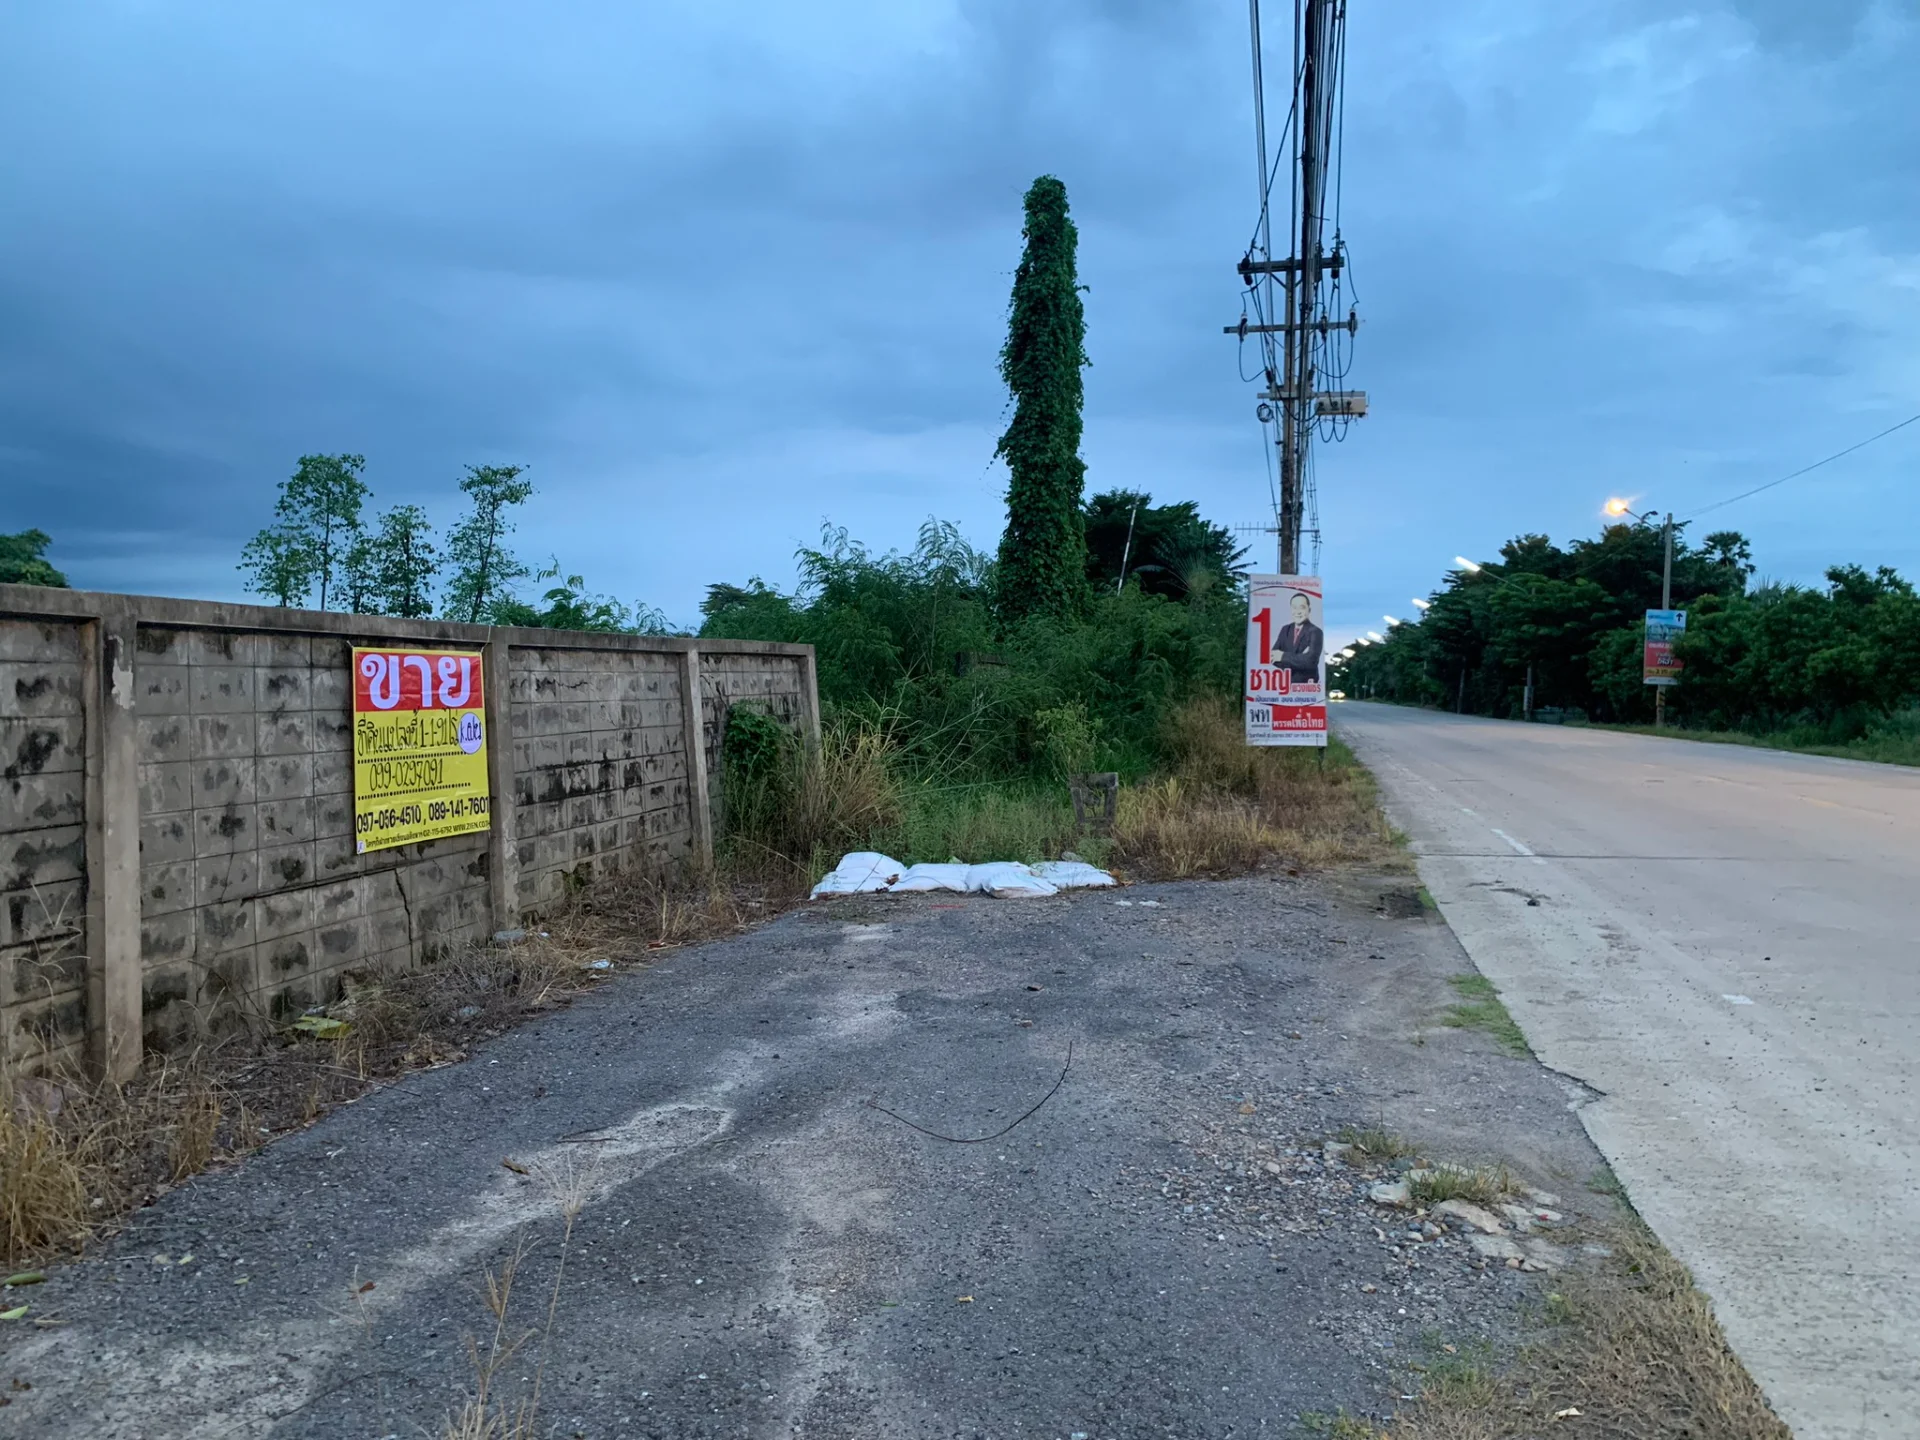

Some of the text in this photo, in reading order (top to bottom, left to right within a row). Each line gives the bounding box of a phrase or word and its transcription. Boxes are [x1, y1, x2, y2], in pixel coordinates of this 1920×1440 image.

[1252, 608, 1271, 664] 1
[361, 653, 471, 709] ขาย
[1250, 669, 1290, 695] ชาญ
[369, 758, 444, 792] 099-0297091
[357, 804, 422, 834] 097-056-4510
[428, 796, 489, 821] 089-141-7601
